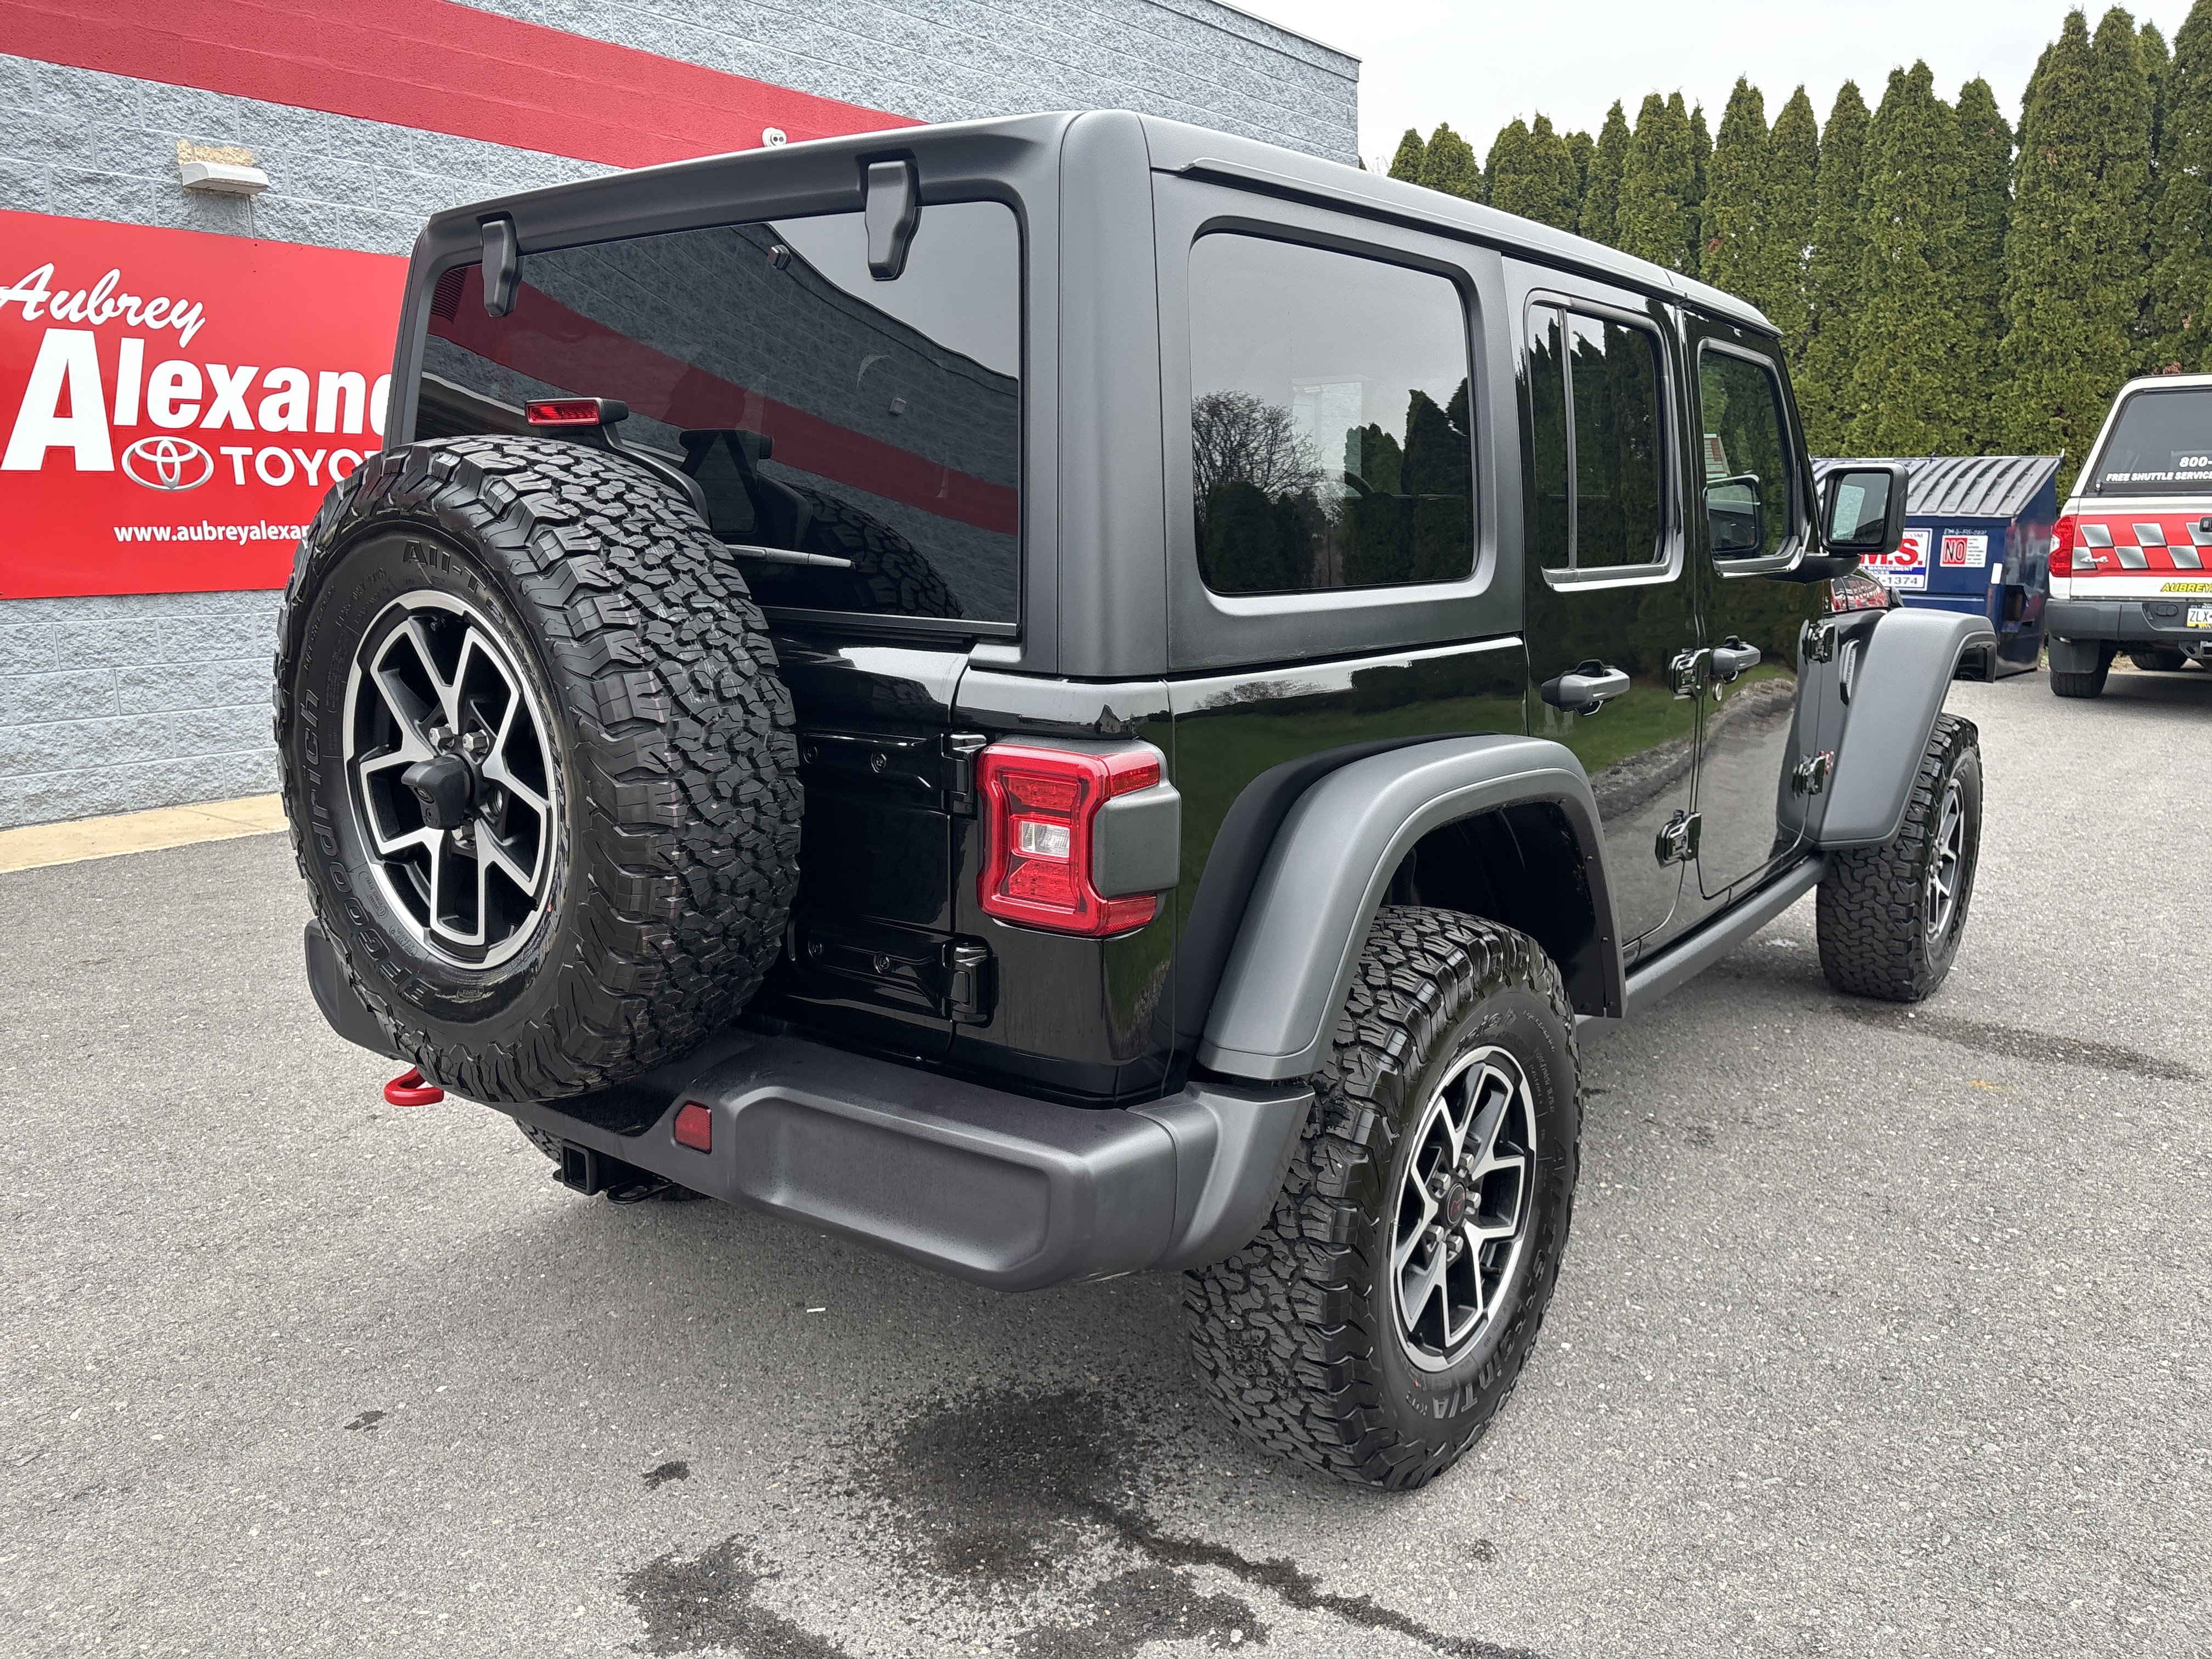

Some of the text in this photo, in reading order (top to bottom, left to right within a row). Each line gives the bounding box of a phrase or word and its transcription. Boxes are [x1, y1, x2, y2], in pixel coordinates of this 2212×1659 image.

[0, 262, 206, 348] Aubrey
[219, 446, 382, 487] TOYO
[2106, 471, 2212, 482] FREE SHUTTLE SERVICE
[1943, 539, 1966, 562] NO
[2160, 583, 2212, 592] AUBREY
[302, 688, 438, 1008] BFGoodrich
